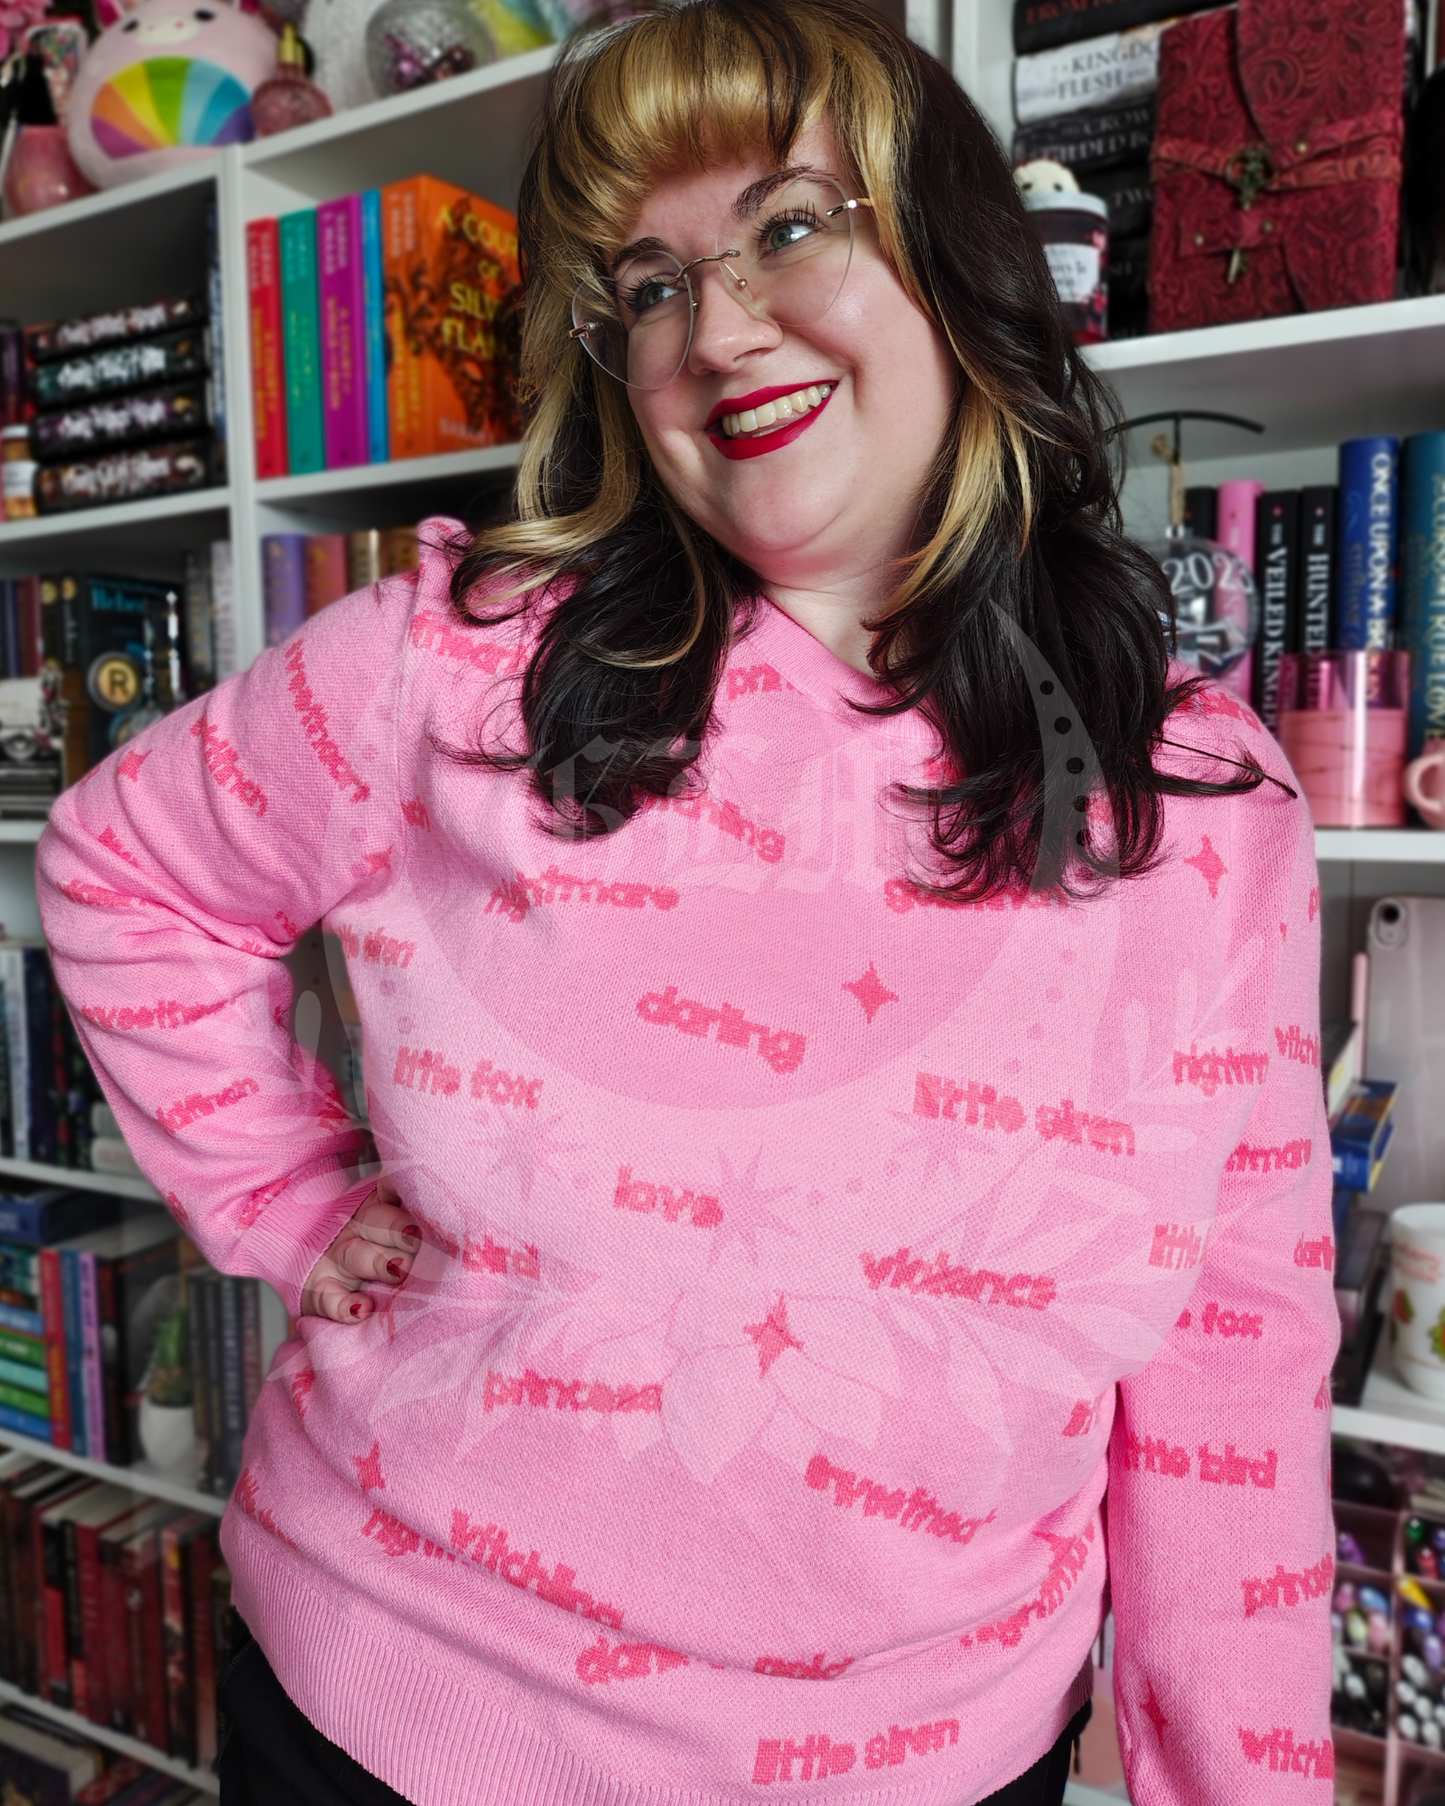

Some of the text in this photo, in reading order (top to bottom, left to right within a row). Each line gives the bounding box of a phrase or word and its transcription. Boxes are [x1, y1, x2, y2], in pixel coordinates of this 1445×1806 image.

[1370, 452, 1392, 518] ONCE
[1367, 521, 1391, 590] UPON
[1265, 547, 1288, 638] VEILED
[1305, 553, 1329, 656] HUNTED
[636, 985, 807, 1075] darling
[470, 1059, 544, 1110] fox
[614, 1166, 724, 1230] love
[1201, 1300, 1264, 1340] fox
[1198, 1442, 1278, 1491] bird
